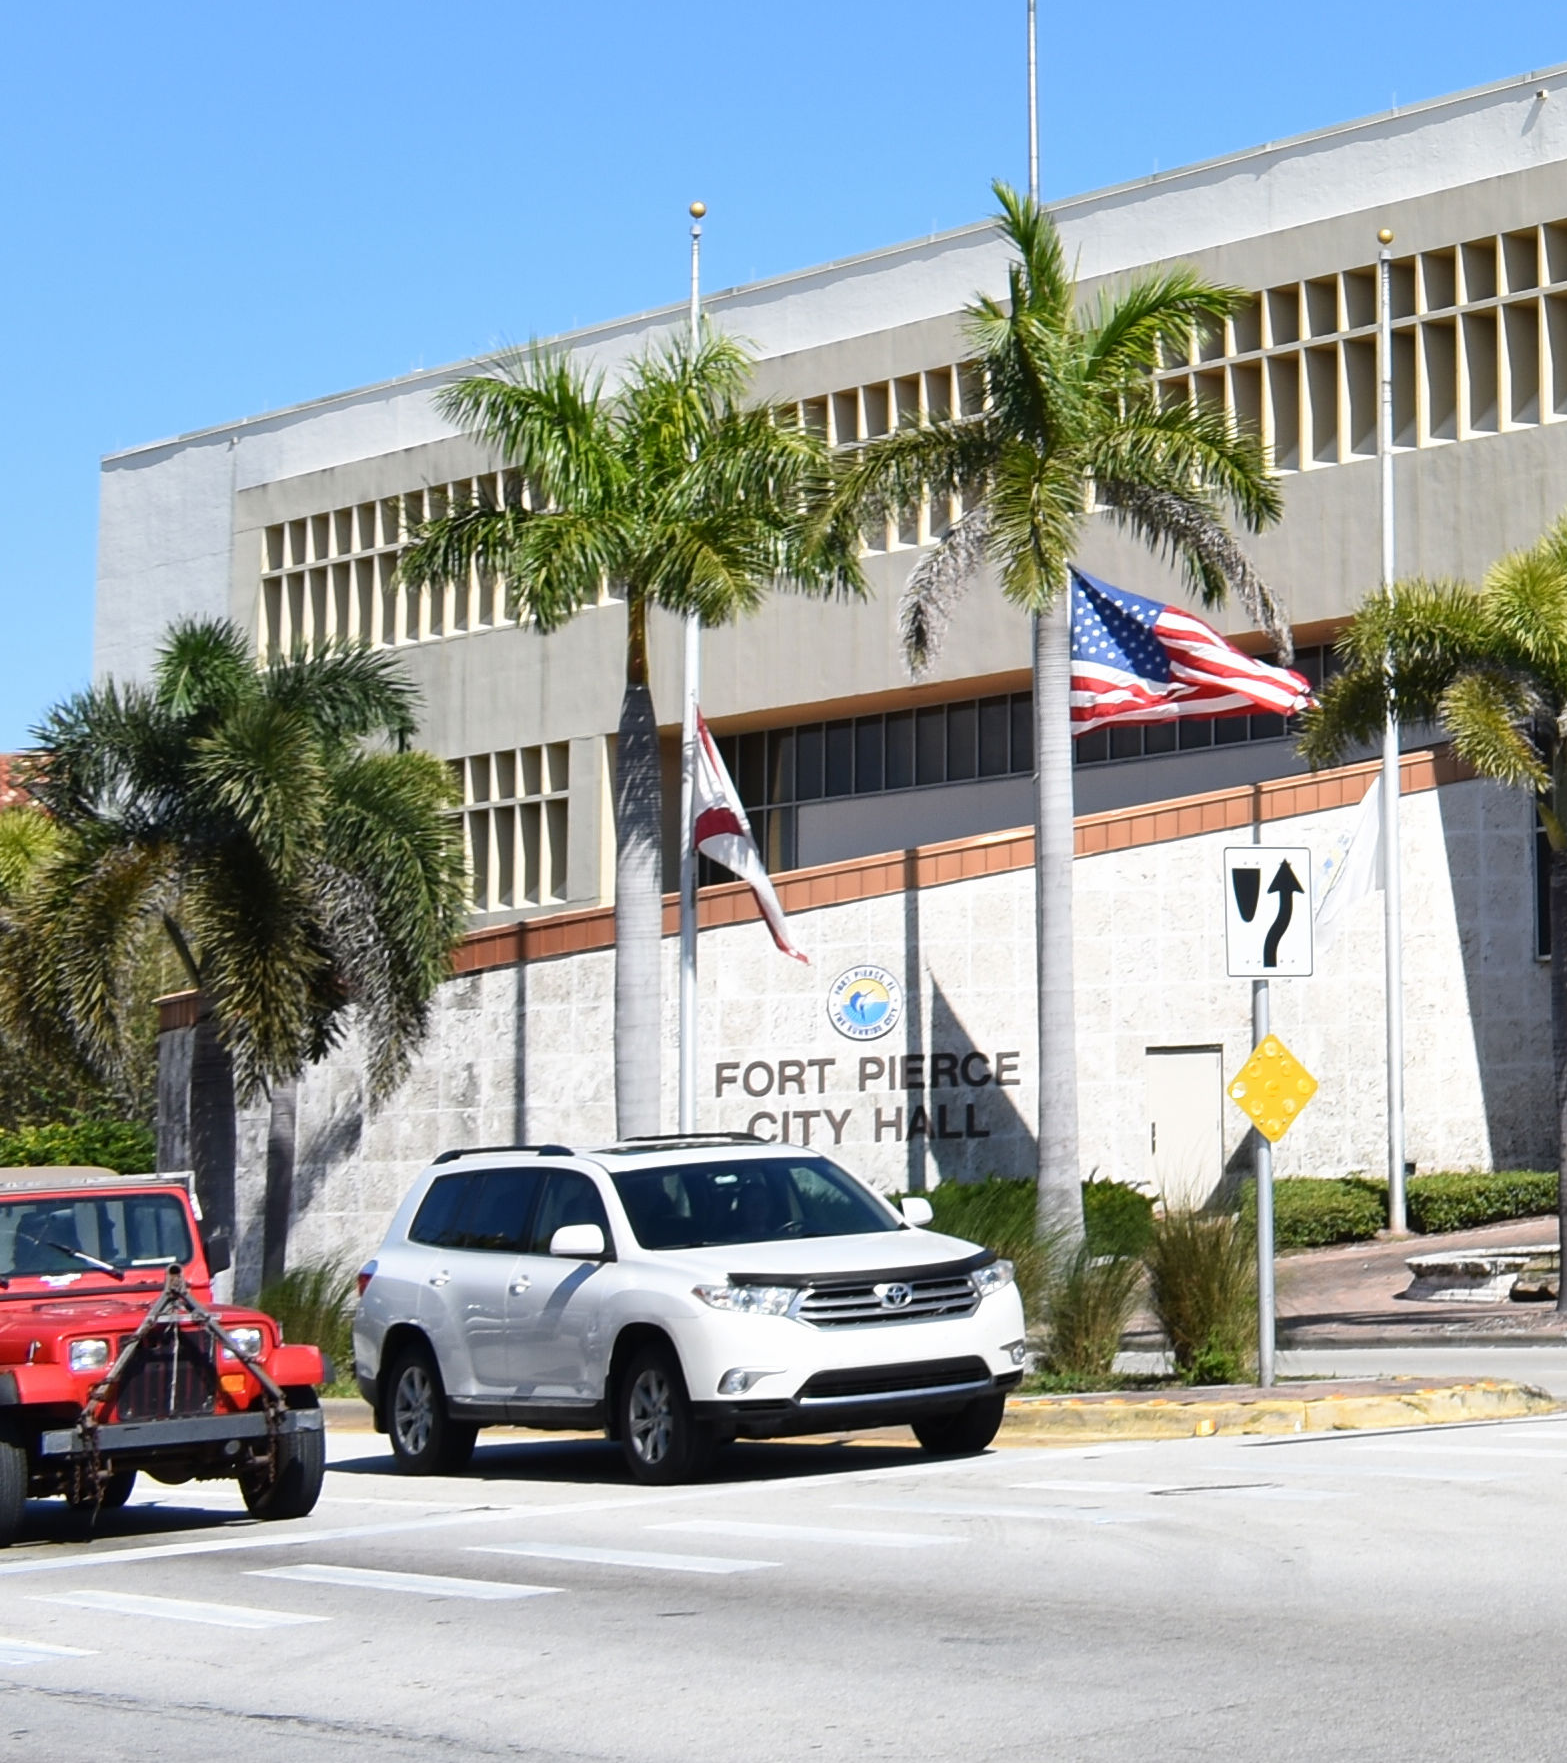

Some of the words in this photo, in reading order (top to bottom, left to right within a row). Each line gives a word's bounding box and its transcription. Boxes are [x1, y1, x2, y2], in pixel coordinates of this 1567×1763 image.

[715, 1058, 836, 1098] FORT
[858, 1051, 1021, 1092] PIERCE
[747, 1108, 852, 1145] CITY
[874, 1103, 990, 1142] HALL
